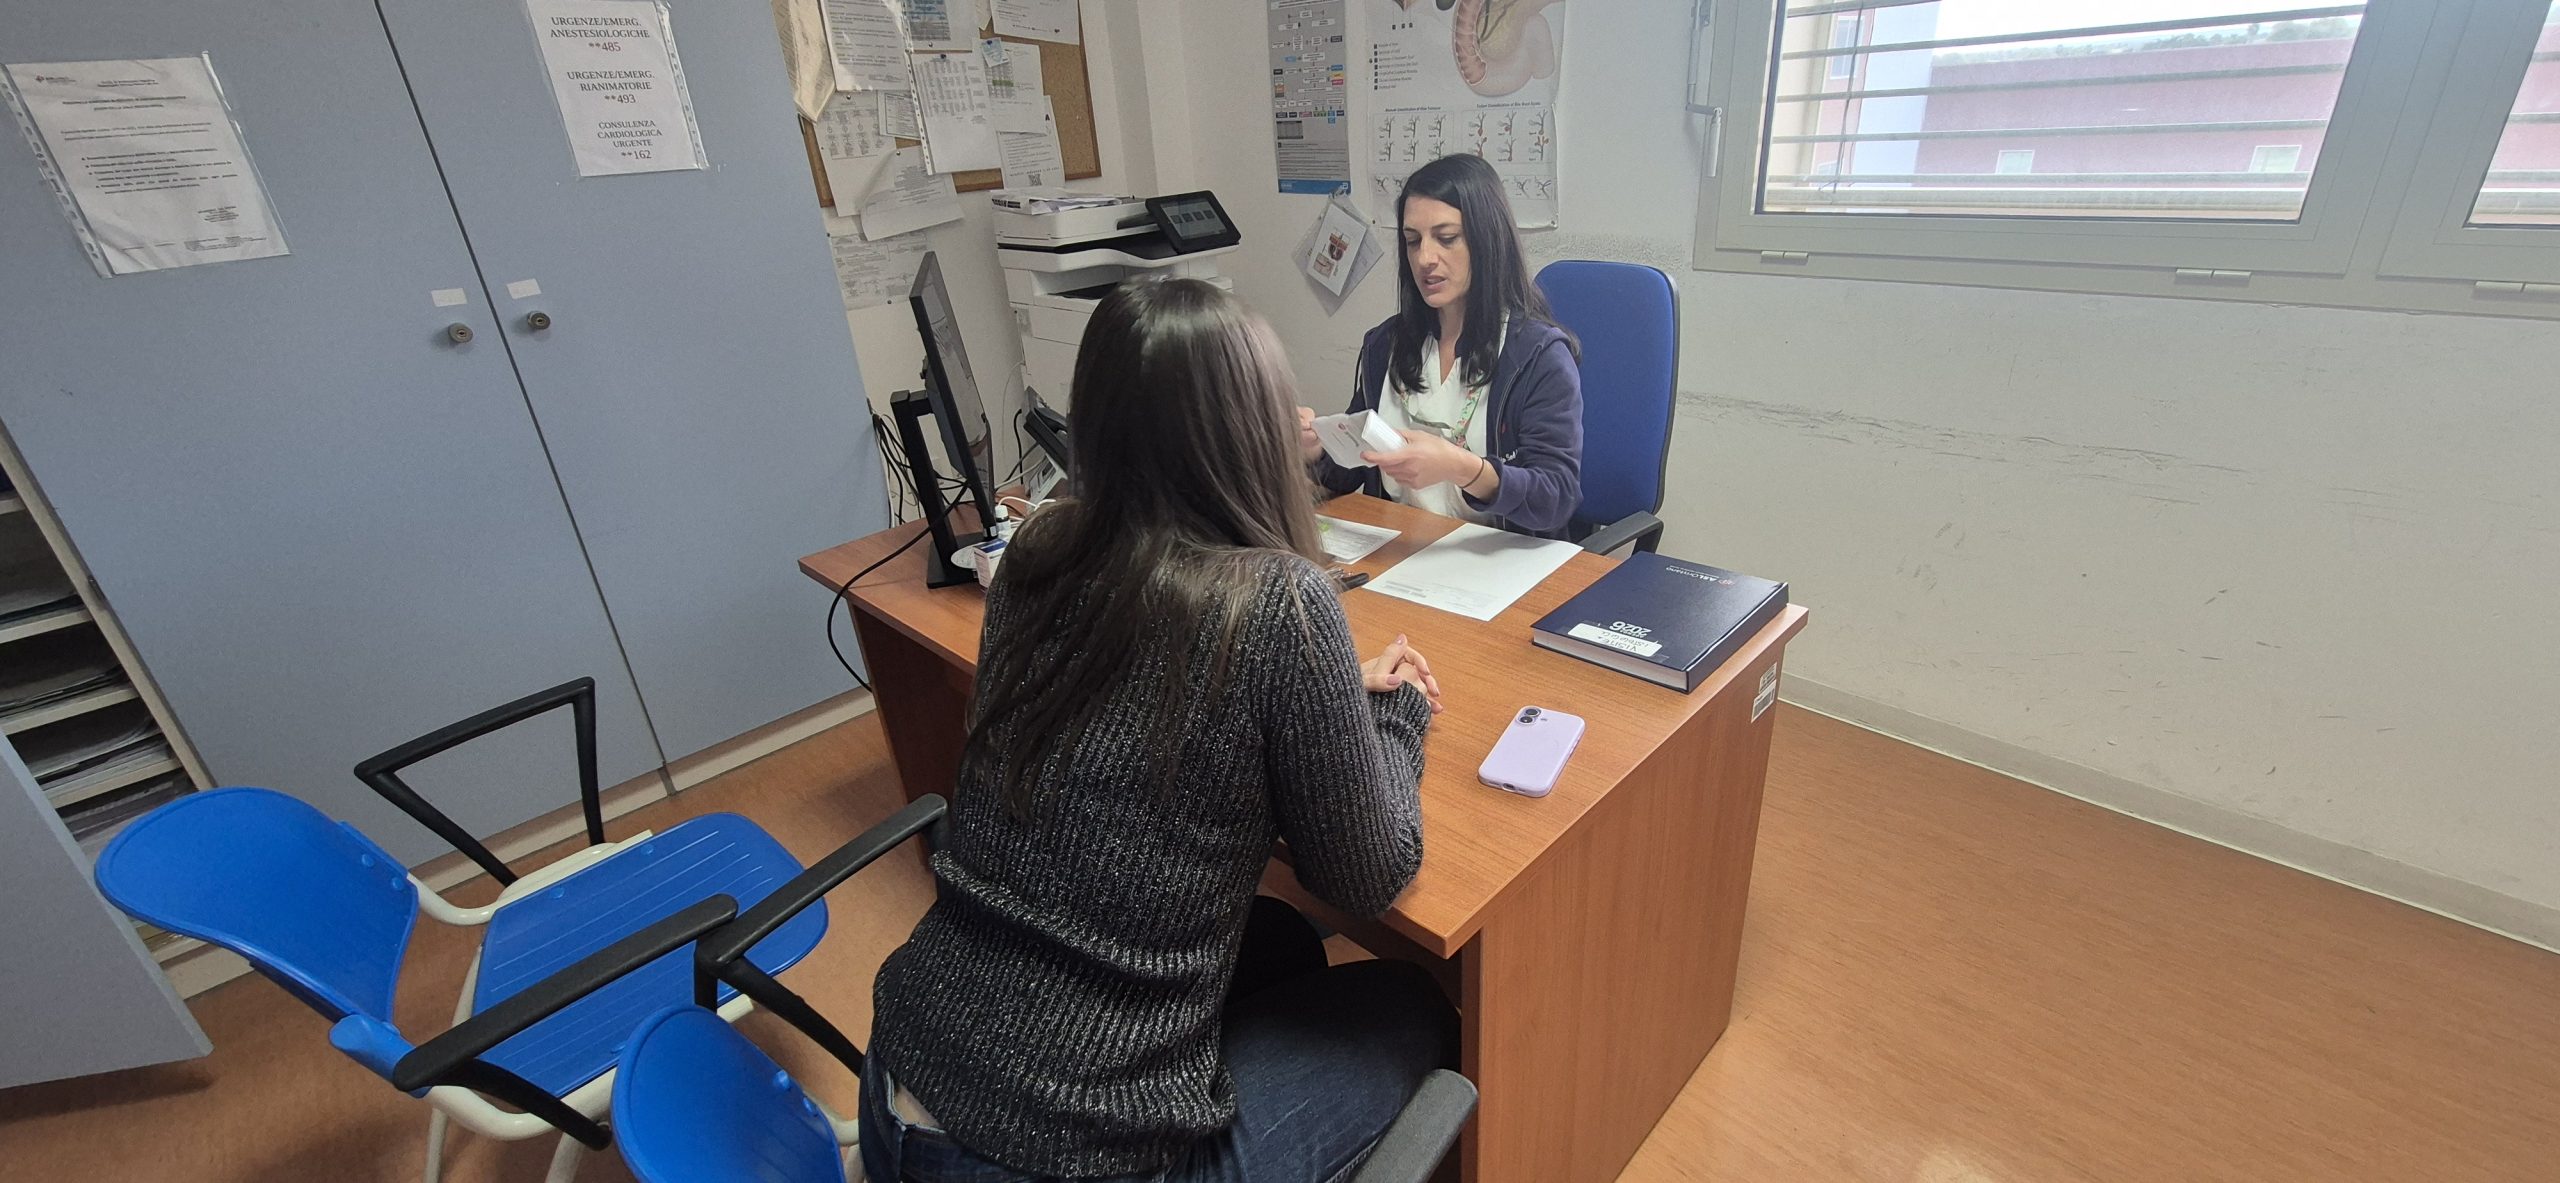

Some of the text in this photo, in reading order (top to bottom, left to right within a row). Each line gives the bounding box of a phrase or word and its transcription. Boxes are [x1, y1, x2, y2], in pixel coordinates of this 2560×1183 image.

[550, 16, 641, 26] URGENZE/EMERG.
[550, 29, 650, 38] ANESTESIOLOGICHE
[566, 70, 655, 80] URGENZE/EMERG.
[579, 81, 653, 91] RIANIMATORIE
[598, 120, 656, 129] CONSULENZA
[597, 129, 663, 139] CARDIOLOGICA
[612, 139, 653, 148] URGENTE
[1609, 621, 1652, 636] 2026
